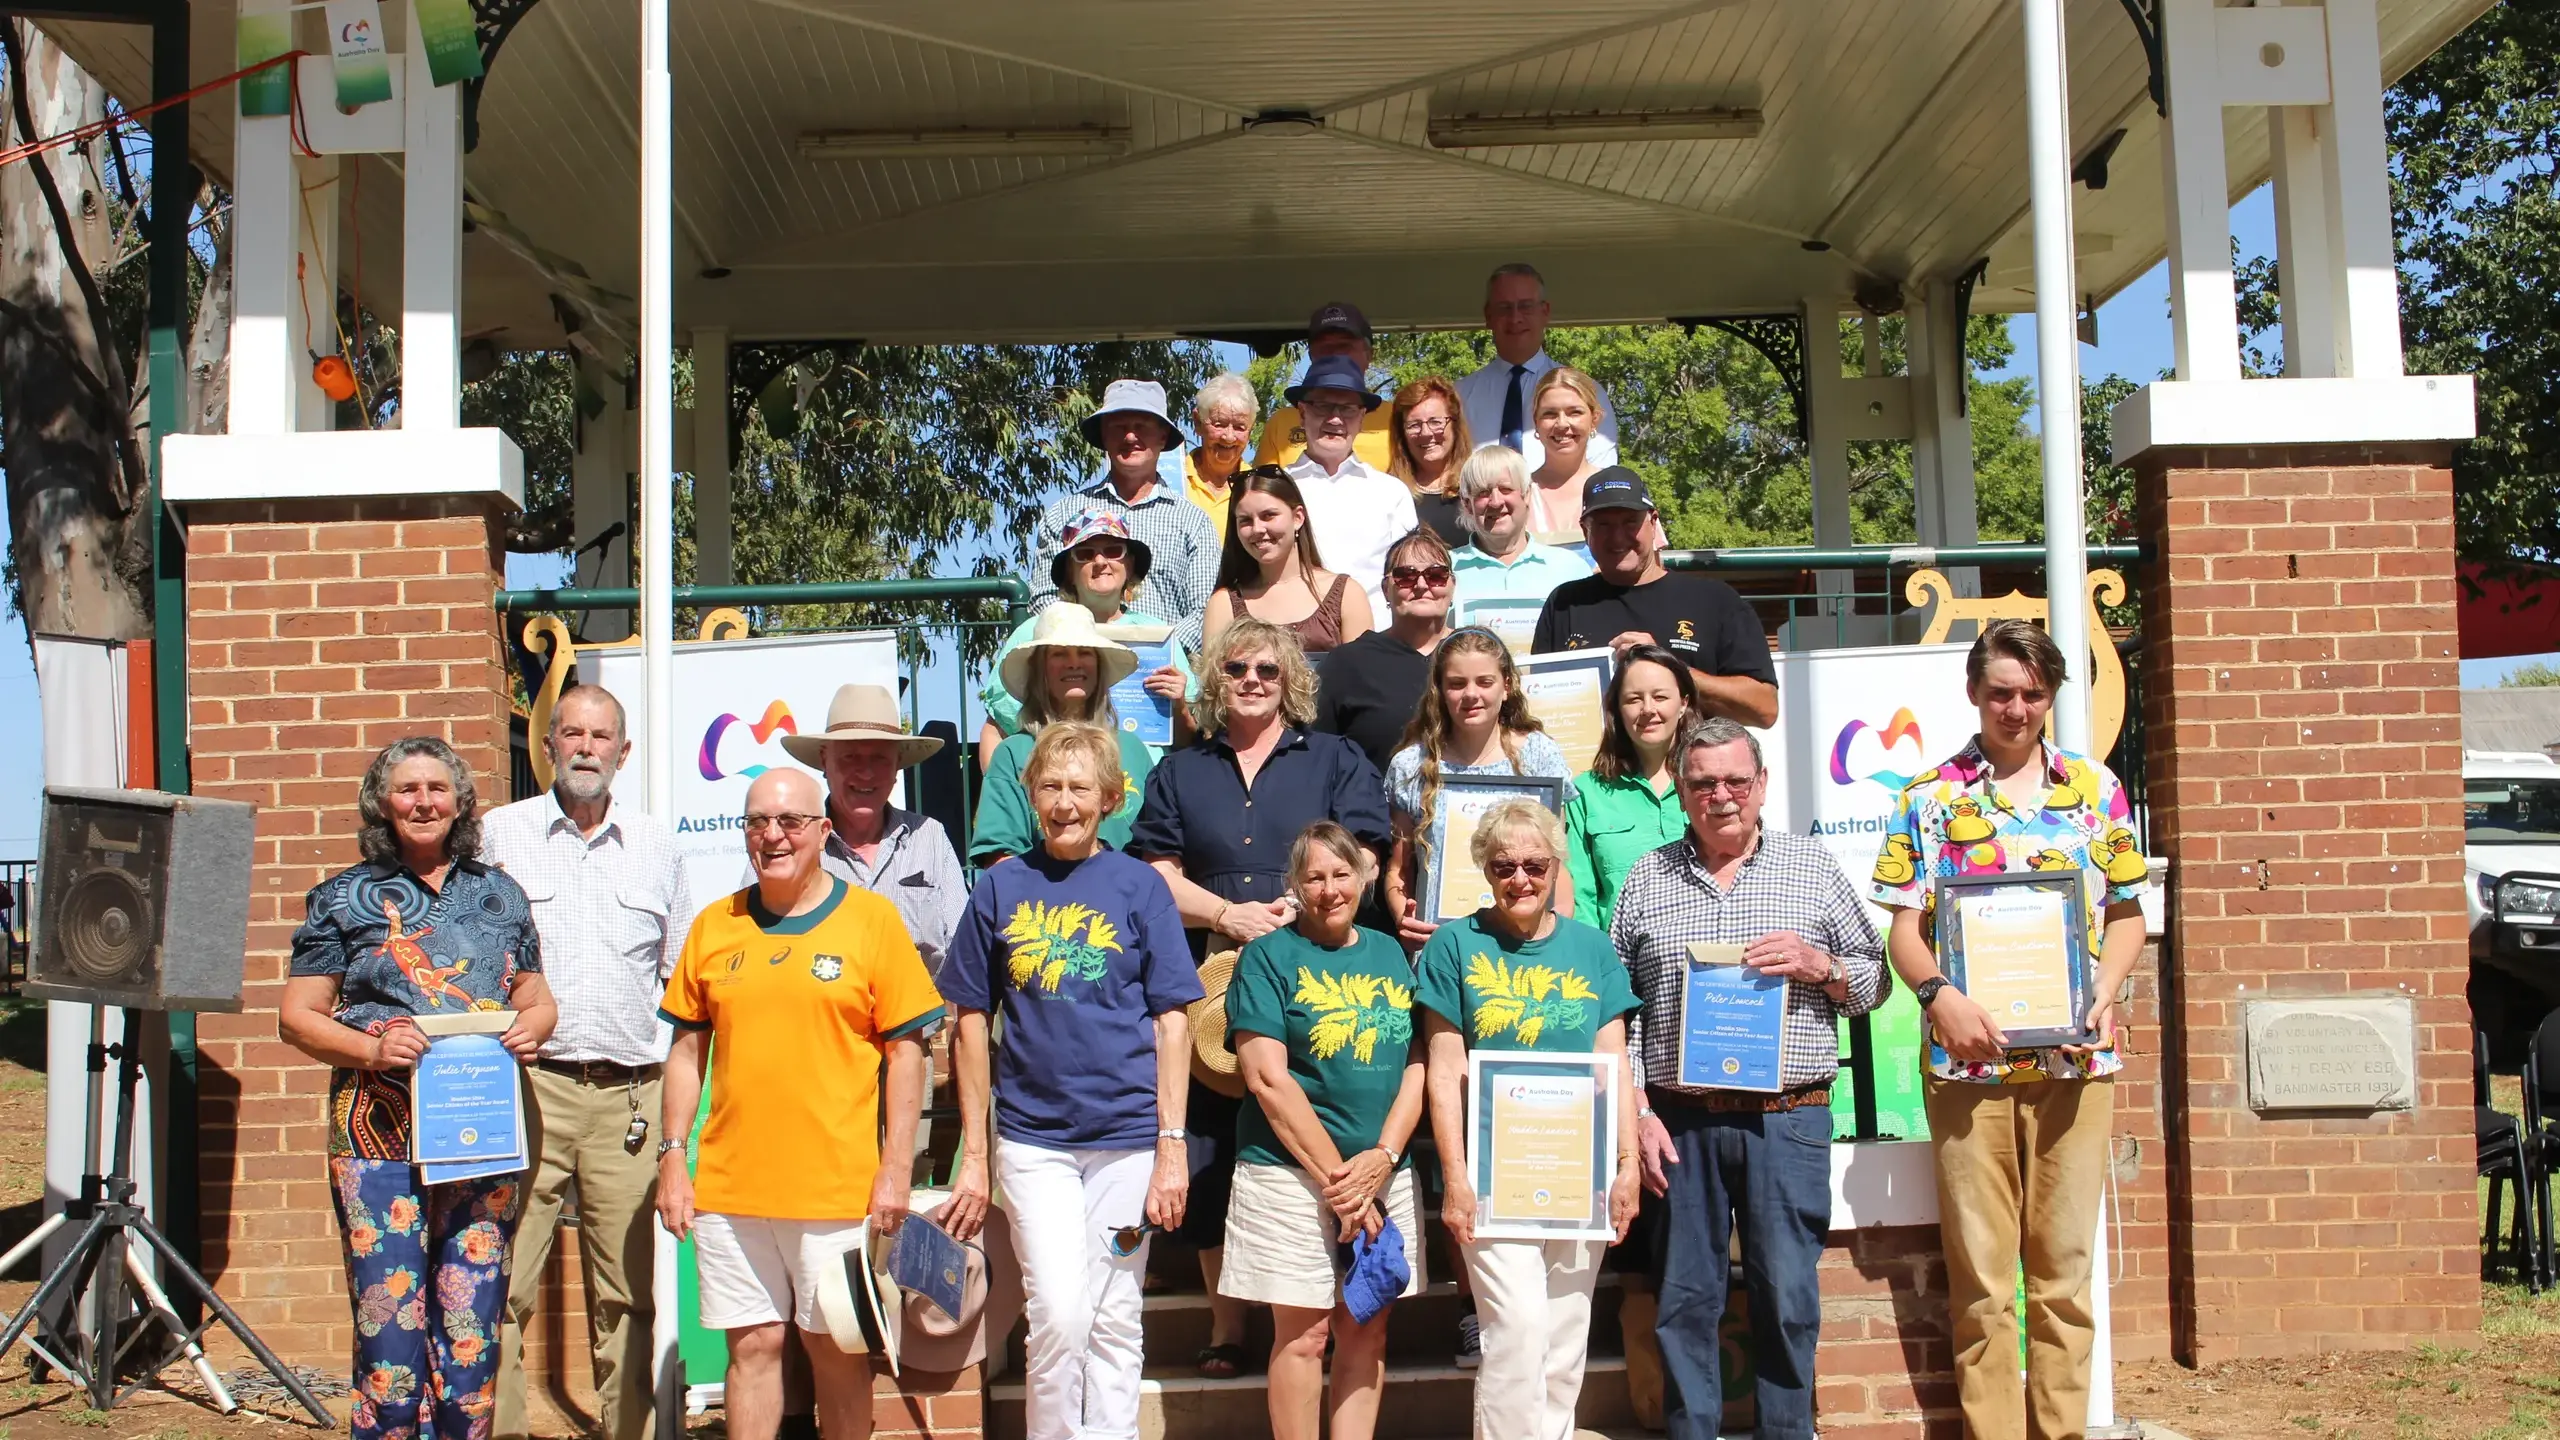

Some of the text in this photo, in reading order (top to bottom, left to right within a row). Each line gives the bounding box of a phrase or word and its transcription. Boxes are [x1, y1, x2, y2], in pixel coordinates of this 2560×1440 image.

[338, 47, 380, 58] Australia Day
[677, 813, 744, 834] Austra
[1809, 815, 1888, 836] Australi
[1704, 992, 1728, 1004] Peter
[2286, 1028, 2352, 1038] VOLUNTARY
[2260, 1045, 2283, 1055] AND
[2288, 1044, 2326, 1055] STONE
[433, 1062, 501, 1079] Julie Ferguson
[2309, 1061, 2356, 1075] GRAY
[1528, 1088, 1574, 1097] Australia Day
[2274, 1082, 2361, 1095] BANDMASTER
